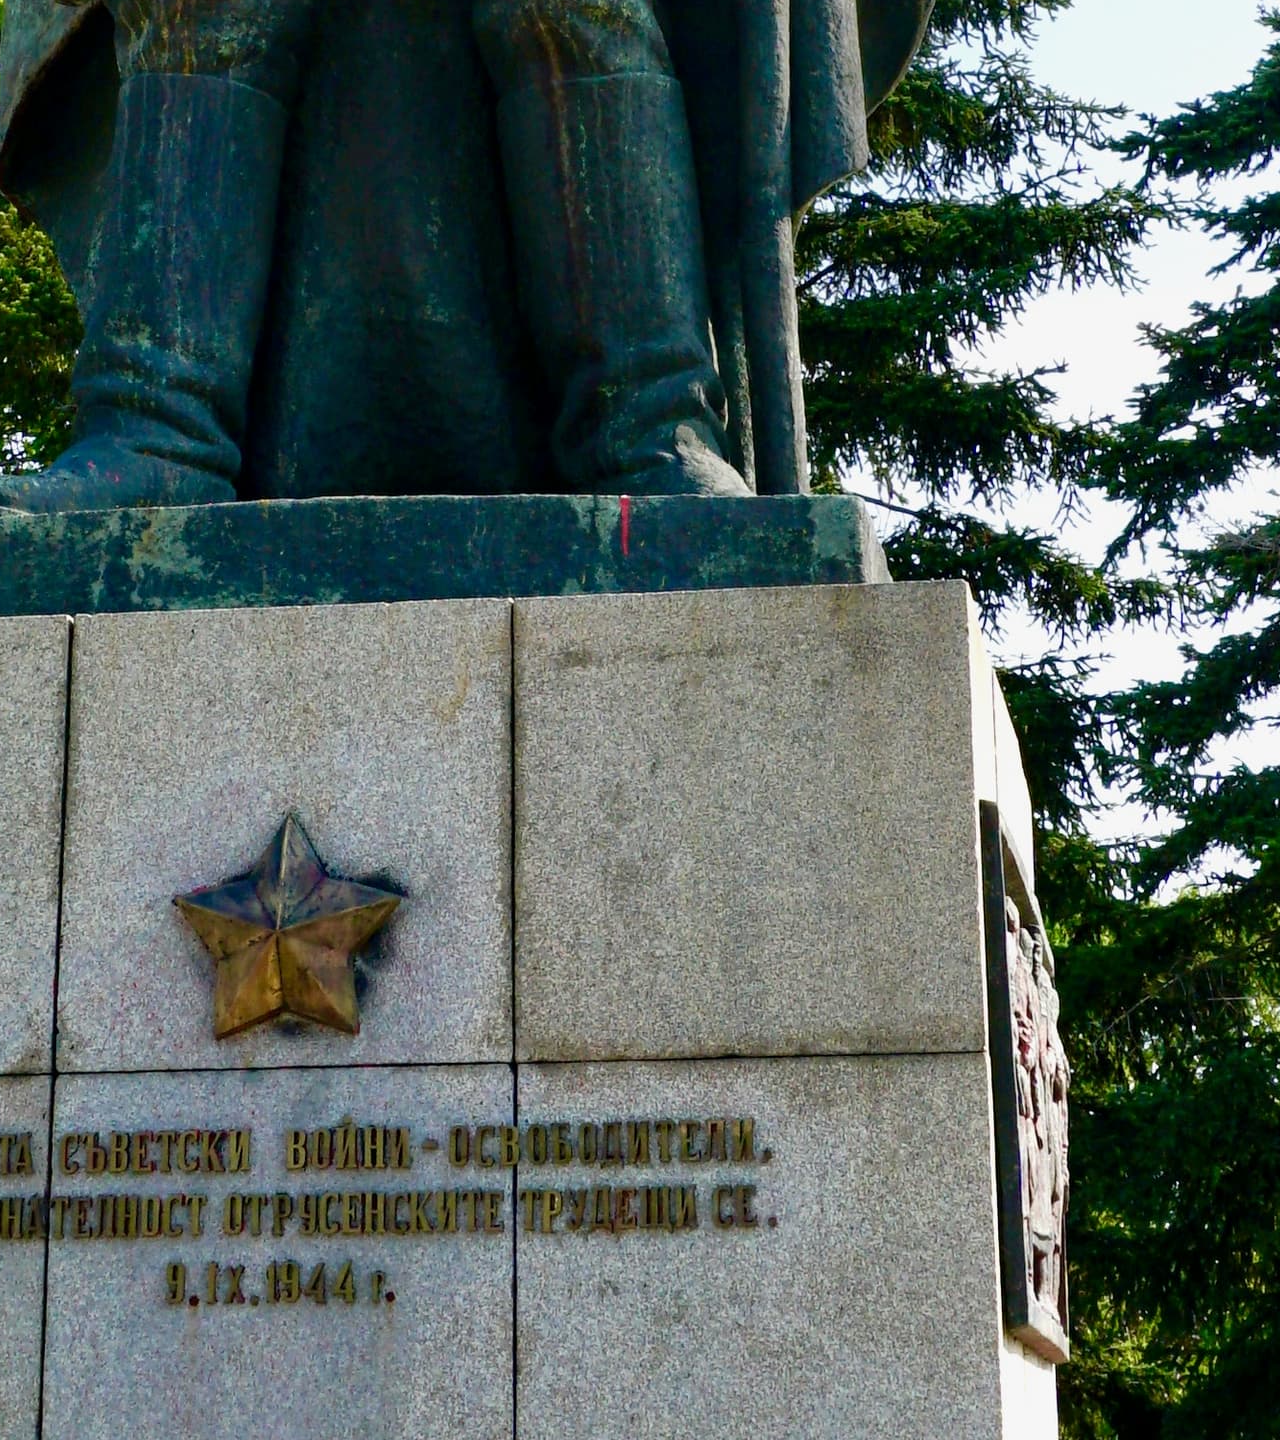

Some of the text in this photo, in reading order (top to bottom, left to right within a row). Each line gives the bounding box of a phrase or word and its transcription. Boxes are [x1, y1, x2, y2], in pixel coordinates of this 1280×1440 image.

[60, 1128, 251, 1175] СЪВЕТСКИ
[521, 1185, 699, 1234] ТРУДЕЩИ
[712, 1185, 778, 1229] СЕ.
